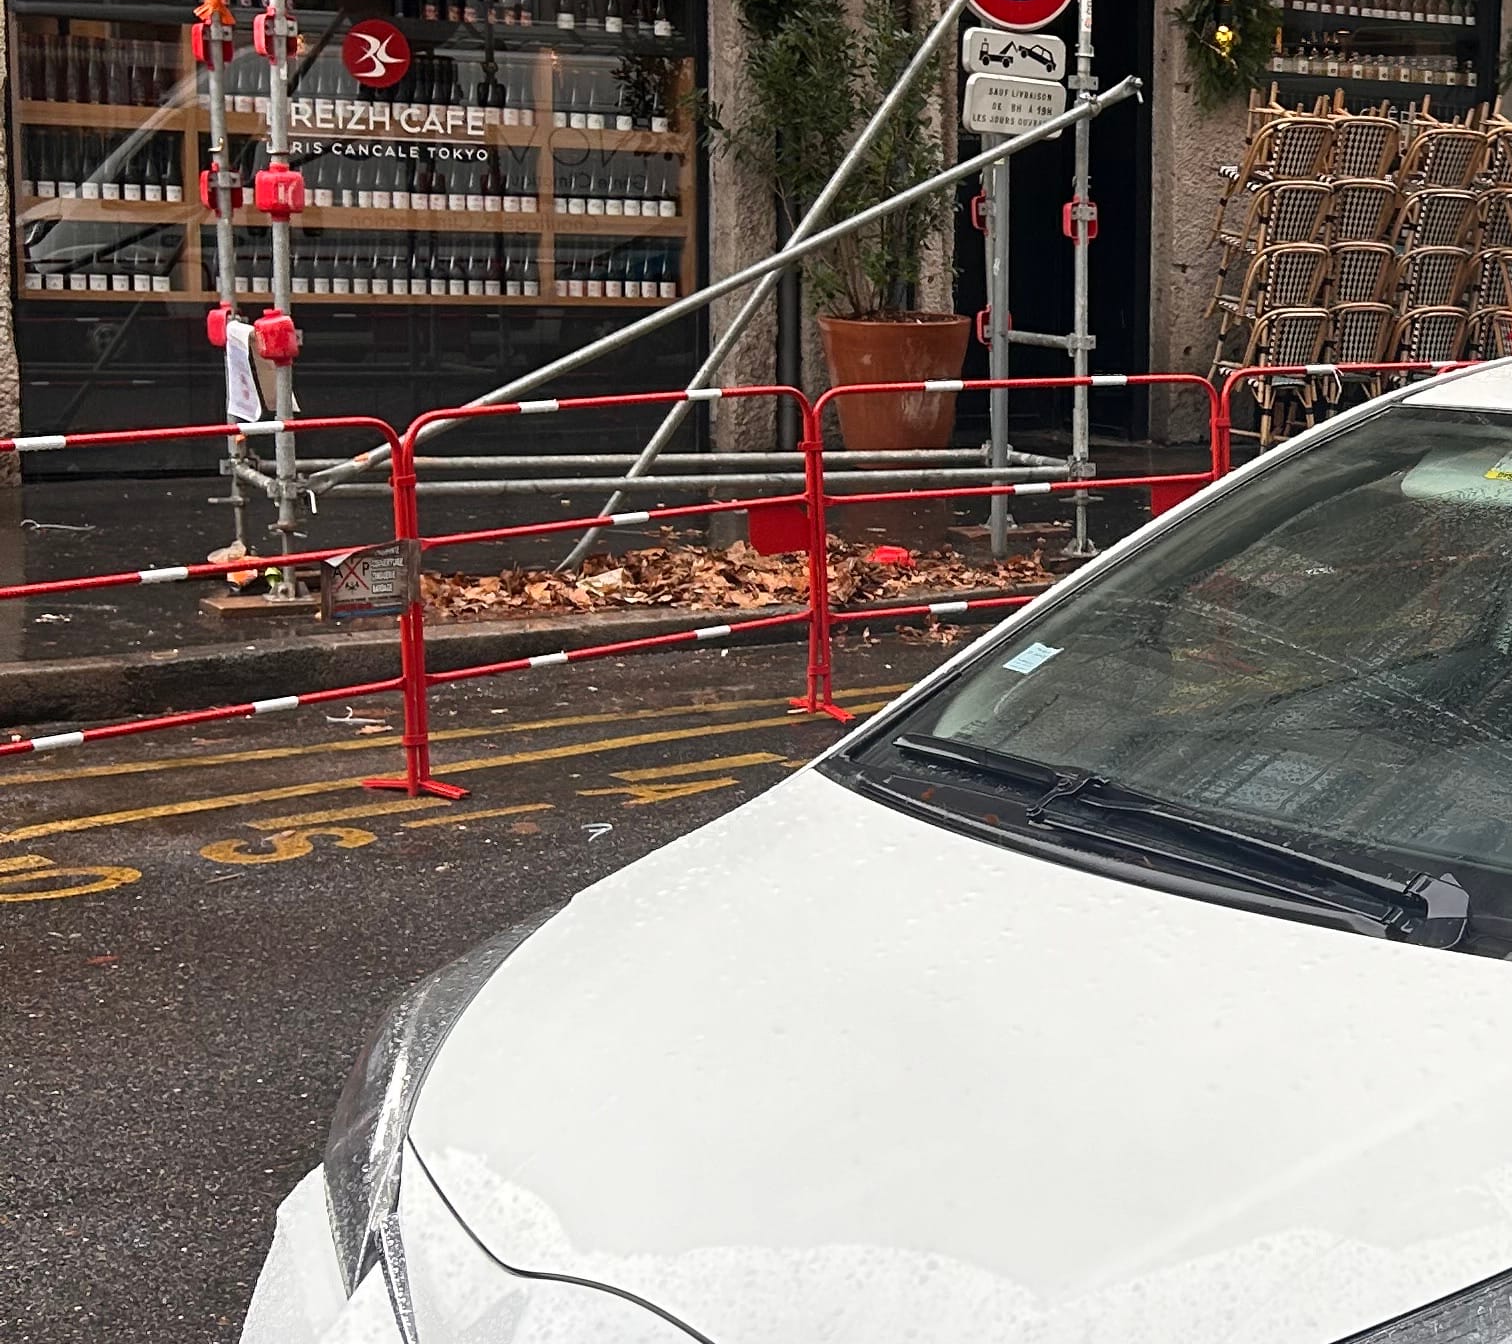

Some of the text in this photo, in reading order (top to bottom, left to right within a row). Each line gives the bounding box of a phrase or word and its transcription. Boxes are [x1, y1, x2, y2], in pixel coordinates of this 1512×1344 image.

[988, 87, 1052, 101] SAUF LIVRAISON
[992, 102, 1002, 111] DE
[1037, 106, 1053, 115] 19H
[401, 108, 485, 136] CAFE
[972, 113, 986, 122] LES
[989, 116, 1015, 126] JOURS
[332, 142, 420, 158] CANCALE
[427, 147, 489, 161] TOKYO
